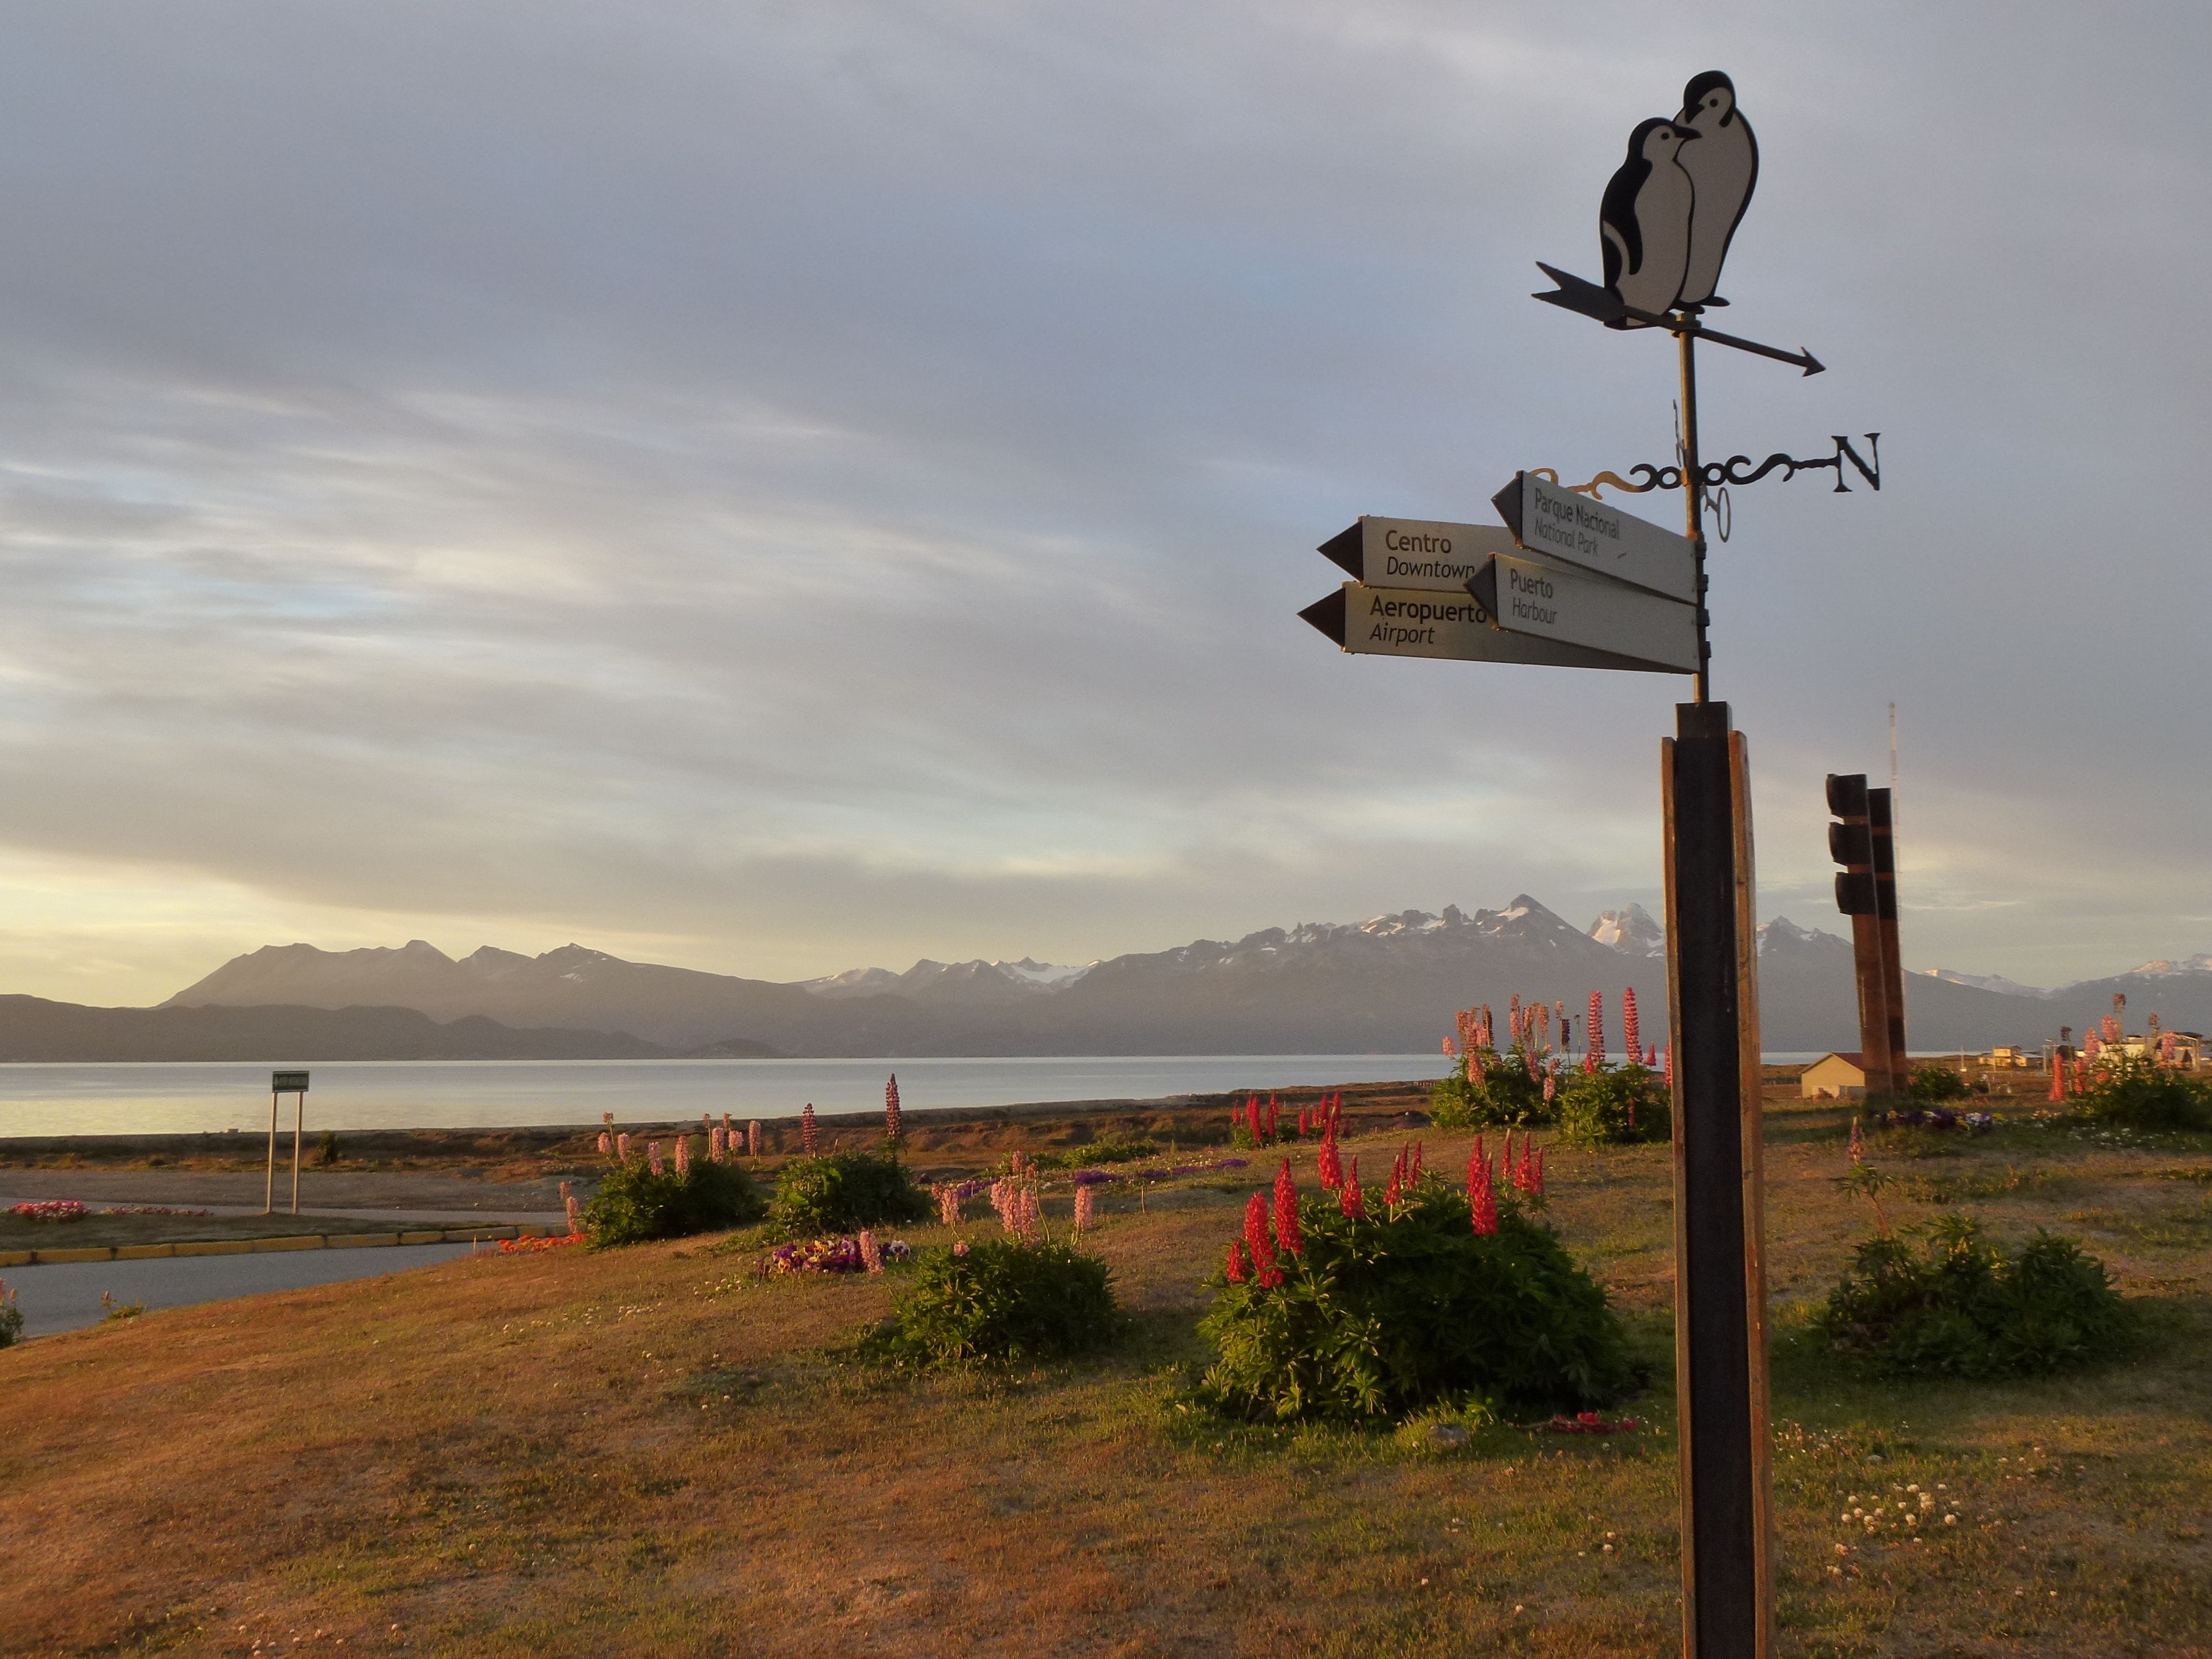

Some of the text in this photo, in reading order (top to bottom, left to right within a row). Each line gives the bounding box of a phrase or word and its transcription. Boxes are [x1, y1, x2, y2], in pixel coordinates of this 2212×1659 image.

[1831, 432, 1881, 493] N
[1535, 487, 1619, 540] Parque Nacional
[1385, 530, 1452, 554] Centro
[1535, 517, 1597, 555] National Park
[1387, 556, 1475, 578] Downtown
[1510, 568, 1553, 599] Puerto
[1370, 595, 1487, 624] Aeropuerto
[1513, 597, 1557, 625] Harbour
[1369, 622, 1435, 646] Airport
